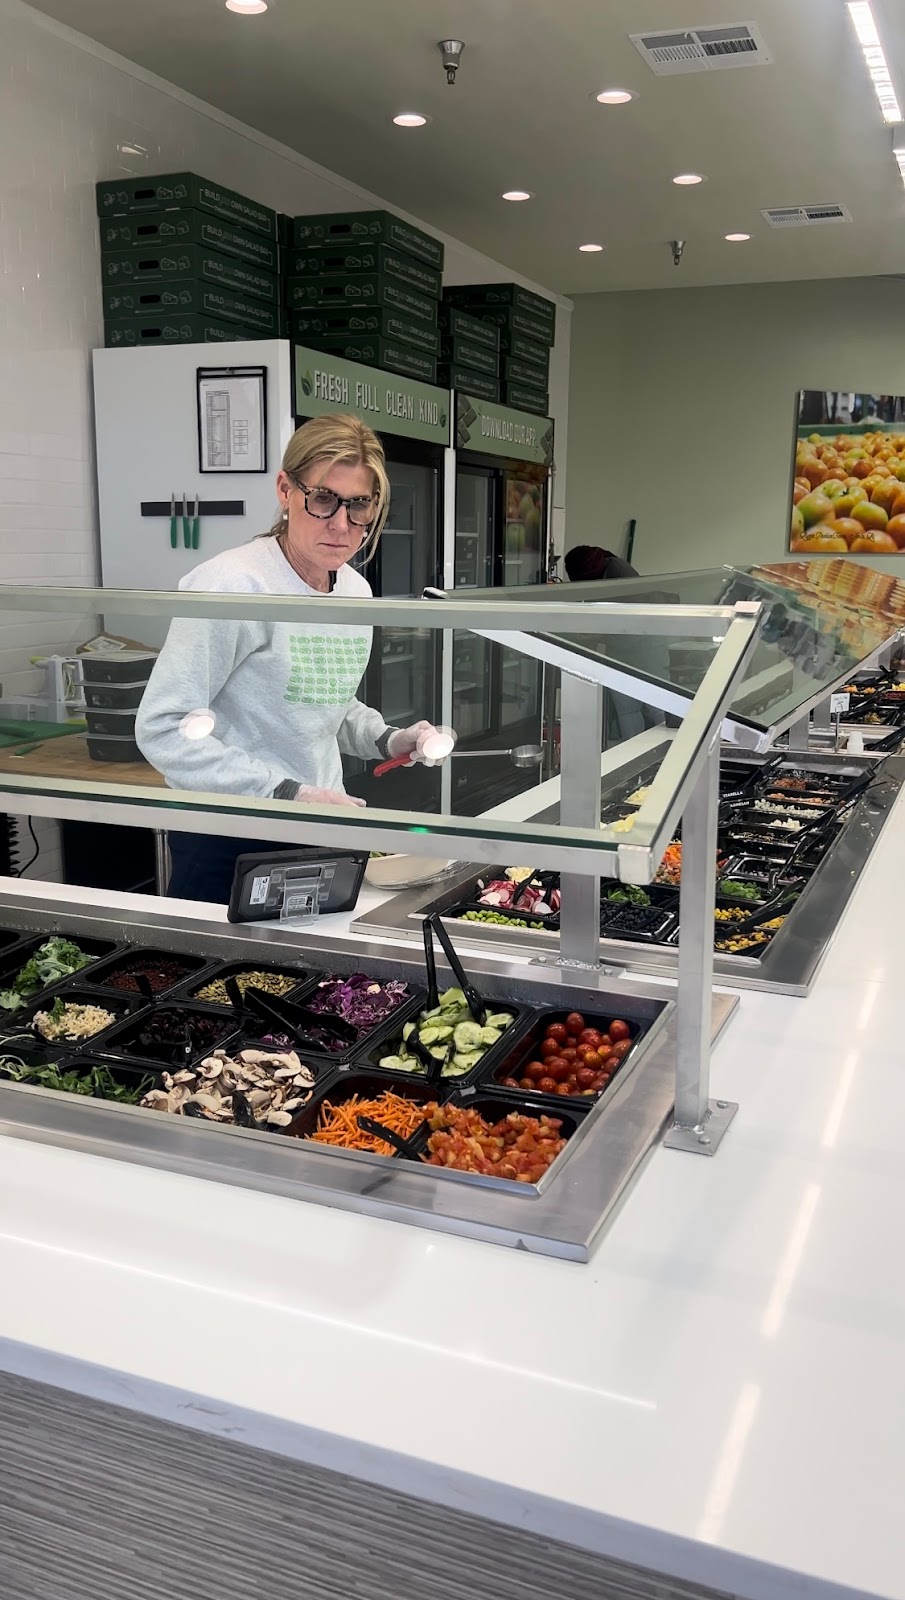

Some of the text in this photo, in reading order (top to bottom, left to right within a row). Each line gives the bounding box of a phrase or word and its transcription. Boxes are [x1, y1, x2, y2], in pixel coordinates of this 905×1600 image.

[205, 189, 220, 201] BUILD
[231, 201, 243, 211] OWN
[244, 206, 257, 217] SALAD
[207, 225, 222, 236] BUILD
[233, 235, 245, 245] OWN
[246, 240, 259, 251] SALAD
[260, 246, 268, 255] BAR
[208, 260, 223, 271] BUILD
[234, 270, 245, 279] OWN
[246, 274, 260, 284] SALAD
[209, 294, 224, 304] BUILD
[235, 302, 246, 311] OWN
[247, 306, 260, 316] SALAD
[210, 328, 224, 338] BUILD
[314, 370, 438, 426] FRESH FULL CLEAN KIND
[482, 415, 536, 447] DOWNLOAD OUR APP
